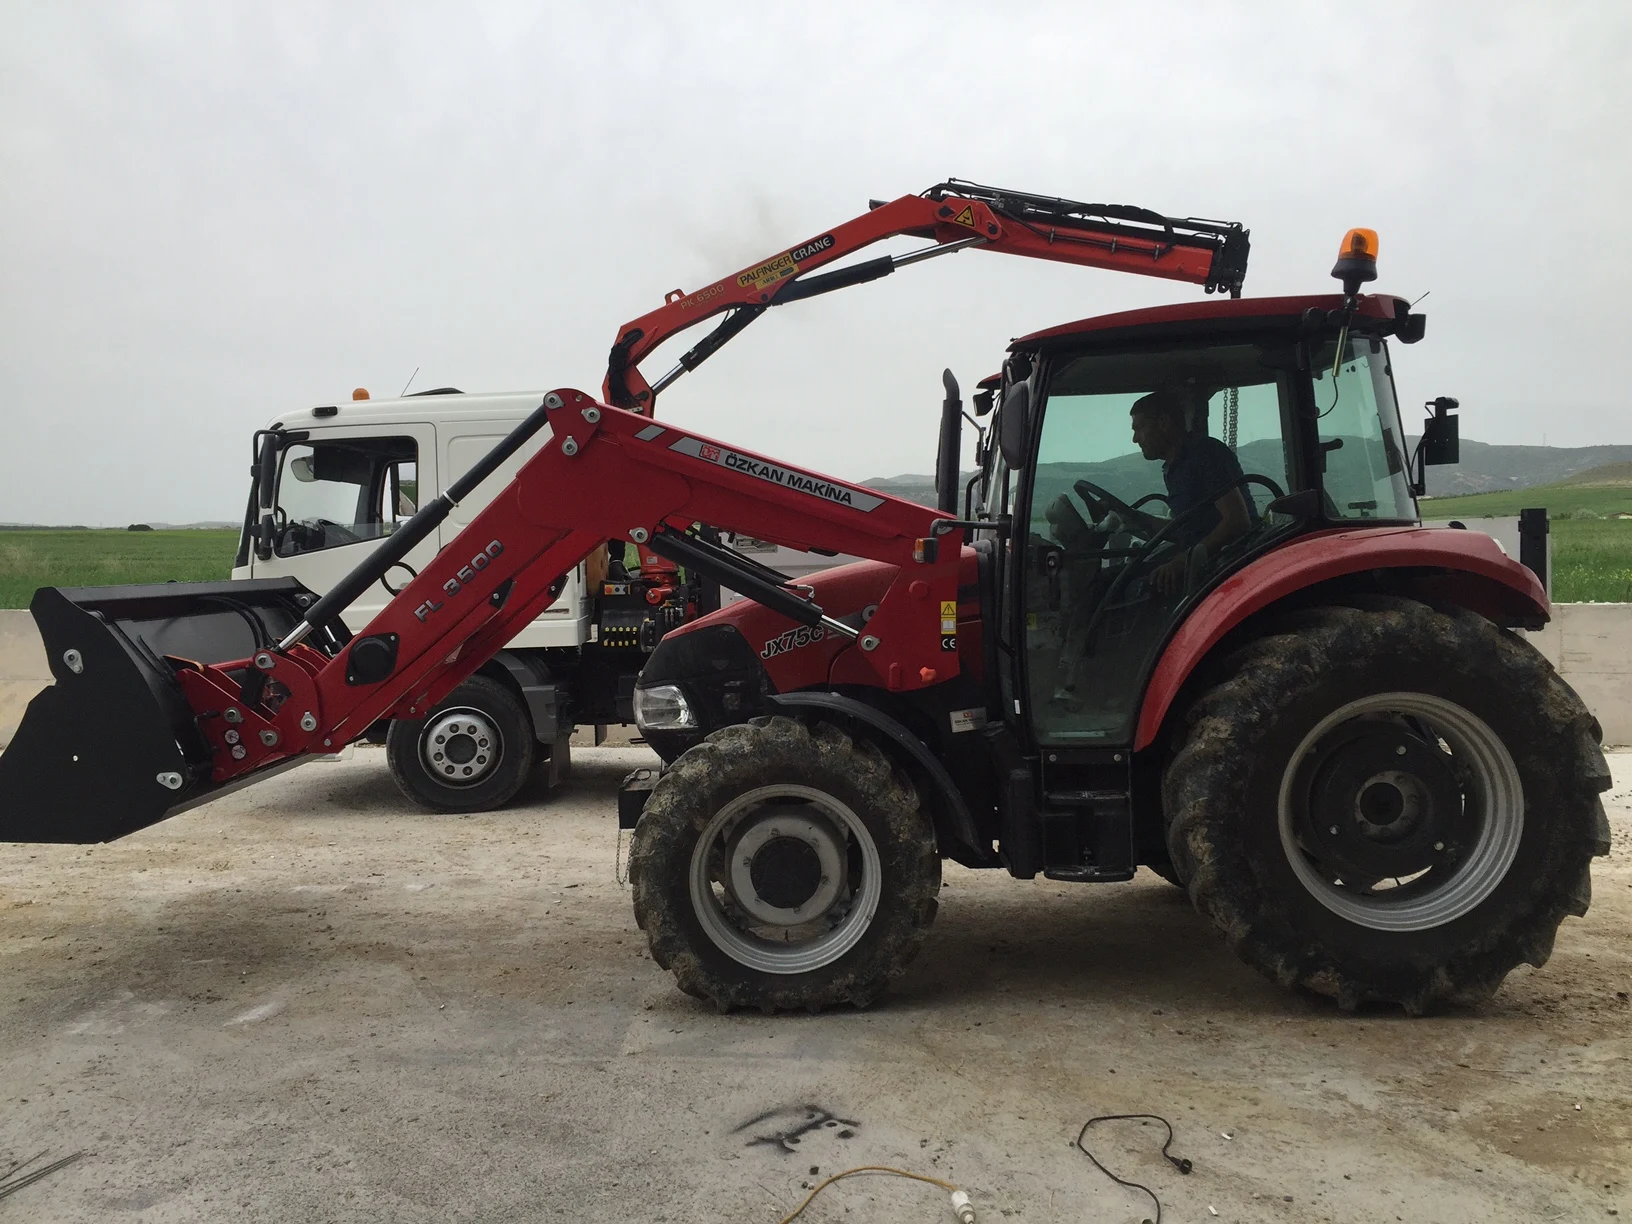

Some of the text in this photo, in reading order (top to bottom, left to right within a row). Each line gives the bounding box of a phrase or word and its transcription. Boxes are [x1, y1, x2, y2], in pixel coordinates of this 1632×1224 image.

[739, 237, 831, 286] PALFINGER CRANE
[680, 298, 695, 310] PK
[696, 284, 724, 302] 6500
[724, 453, 784, 482] ÖZKAN
[787, 474, 852, 505] MAKİNA
[413, 539, 504, 623] FL 3500
[760, 624, 824, 659] JX75C
